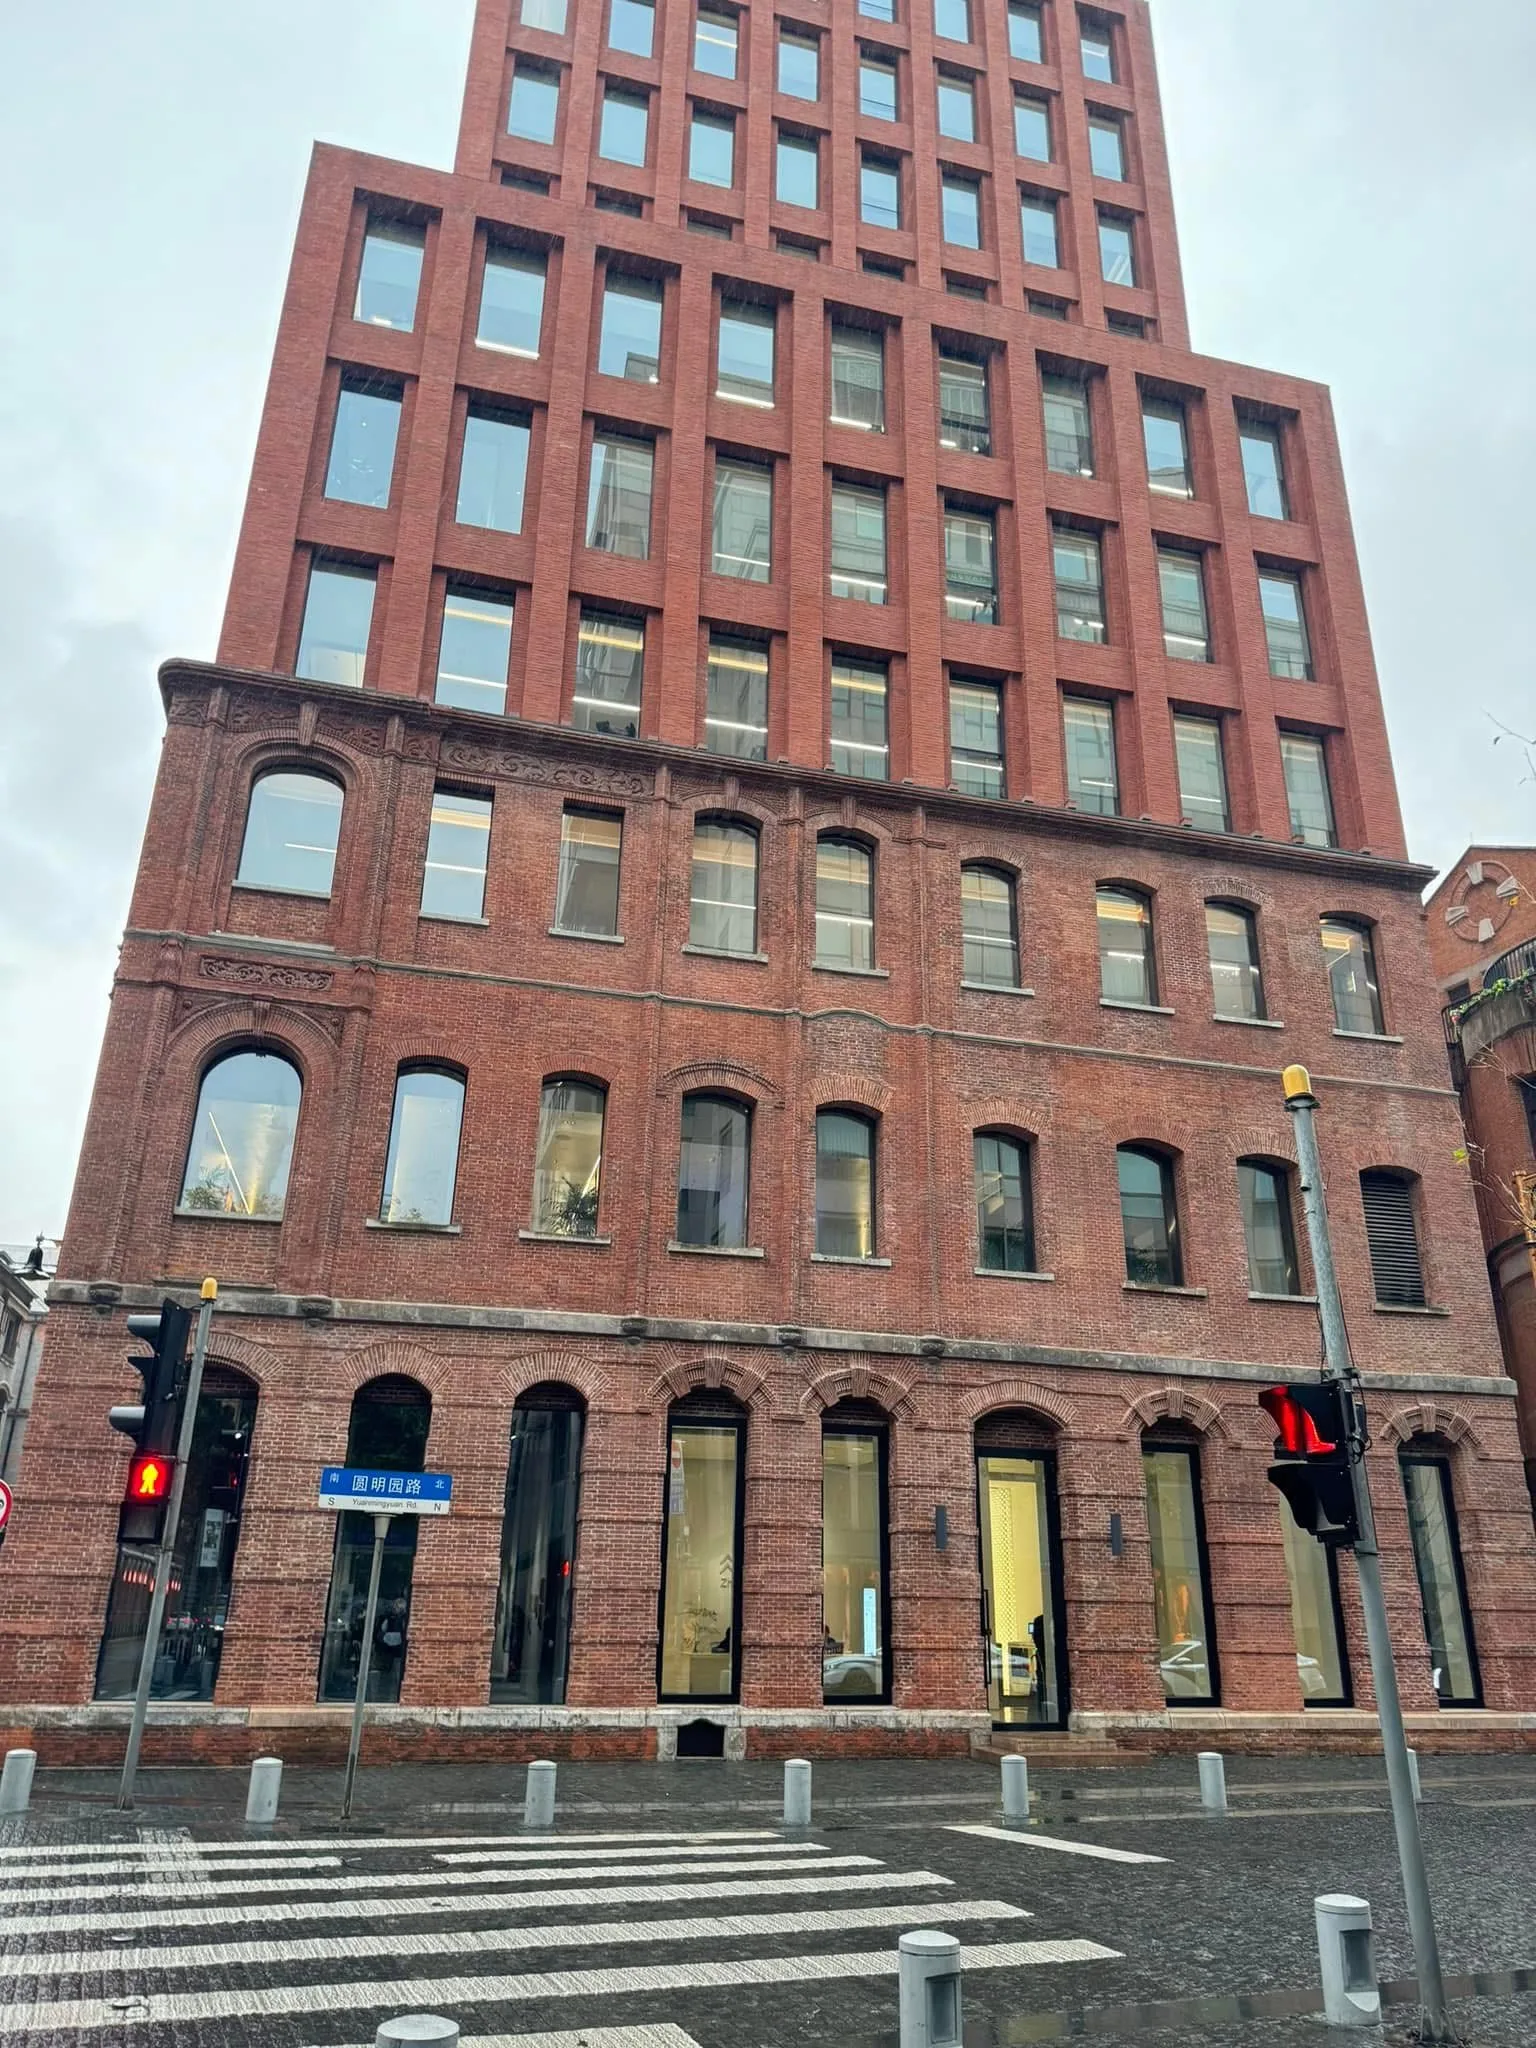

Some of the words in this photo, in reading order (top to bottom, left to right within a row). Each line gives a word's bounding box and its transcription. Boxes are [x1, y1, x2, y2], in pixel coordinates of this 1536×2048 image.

[329, 1472, 339, 1484] 南
[352, 1475, 421, 1495] 圆明园路
[434, 1479, 445, 1489] 北
[328, 1496, 336, 1506] S
[433, 1503, 441, 1511] N
